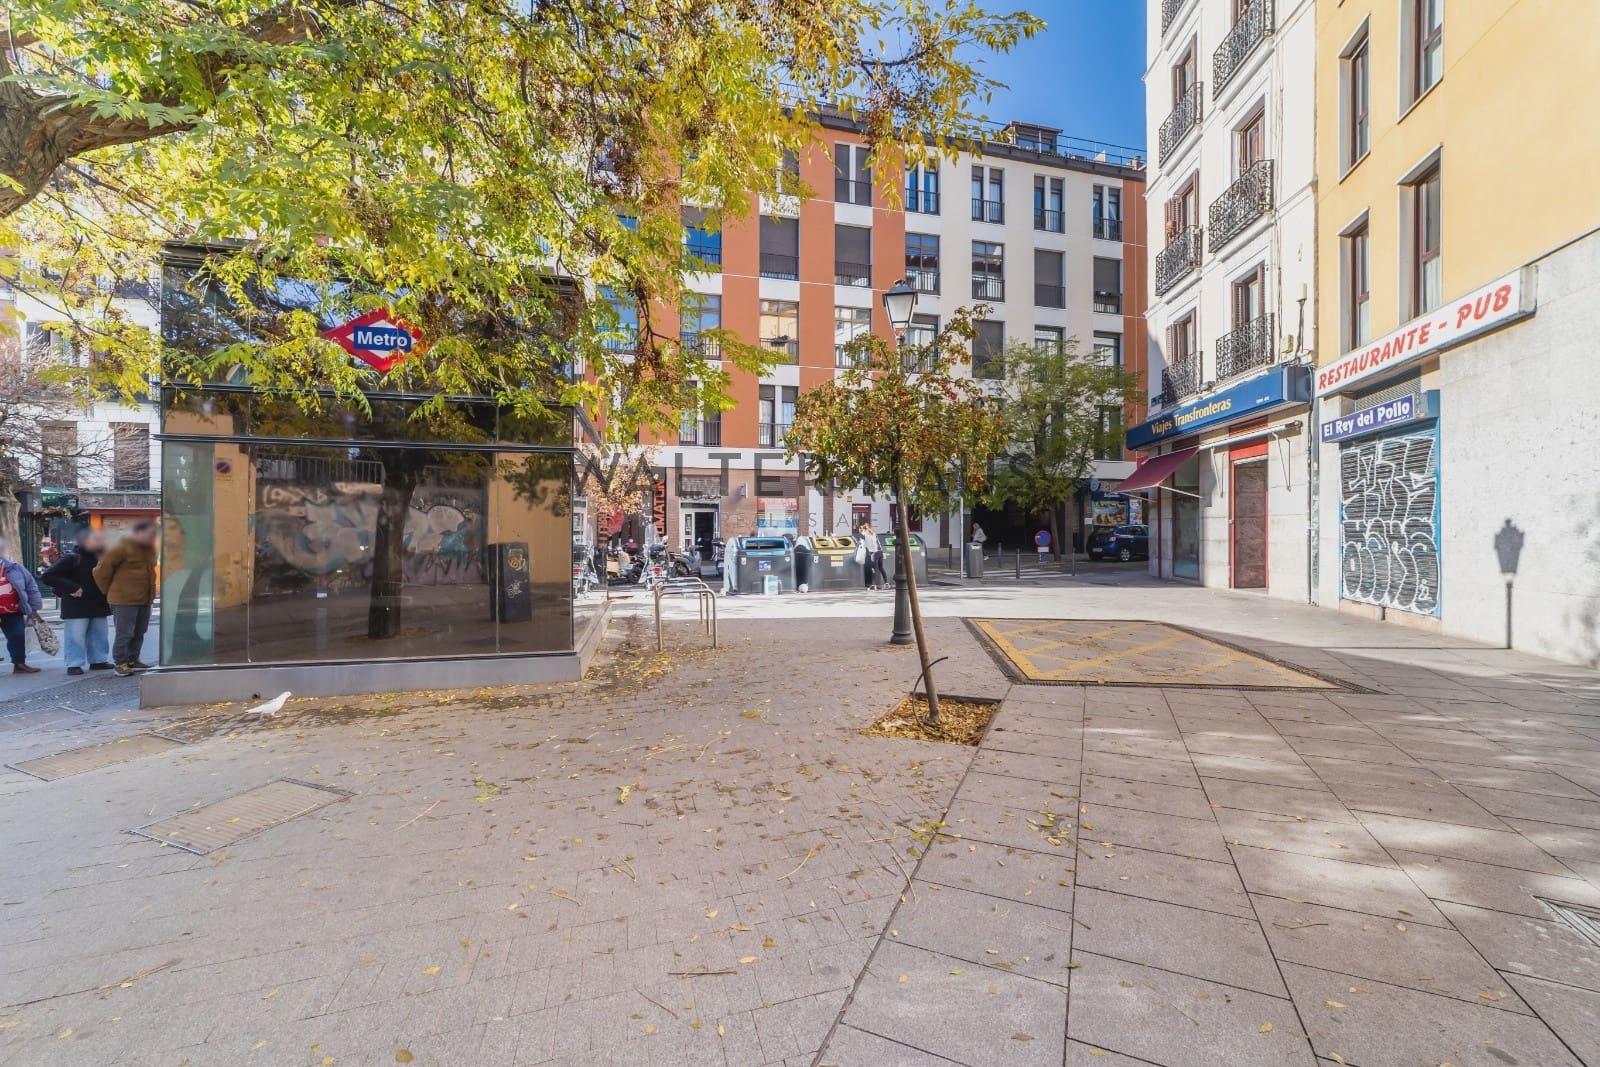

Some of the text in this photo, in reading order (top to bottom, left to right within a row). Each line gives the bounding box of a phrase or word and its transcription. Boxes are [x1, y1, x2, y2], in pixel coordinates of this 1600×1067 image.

[357, 331, 407, 347] Metro
[1318, 322, 1431, 390] RESTAURANTE
[1456, 284, 1512, 329] PUB
[1151, 419, 1172, 435] Viajes
[1174, 398, 1232, 427] Transfronteras
[1323, 424, 1333, 438] El
[1336, 419, 1354, 435] Rey
[1357, 410, 1373, 427] del
[1377, 401, 1410, 422] Pollo
[653, 480, 666, 535] OMATON
